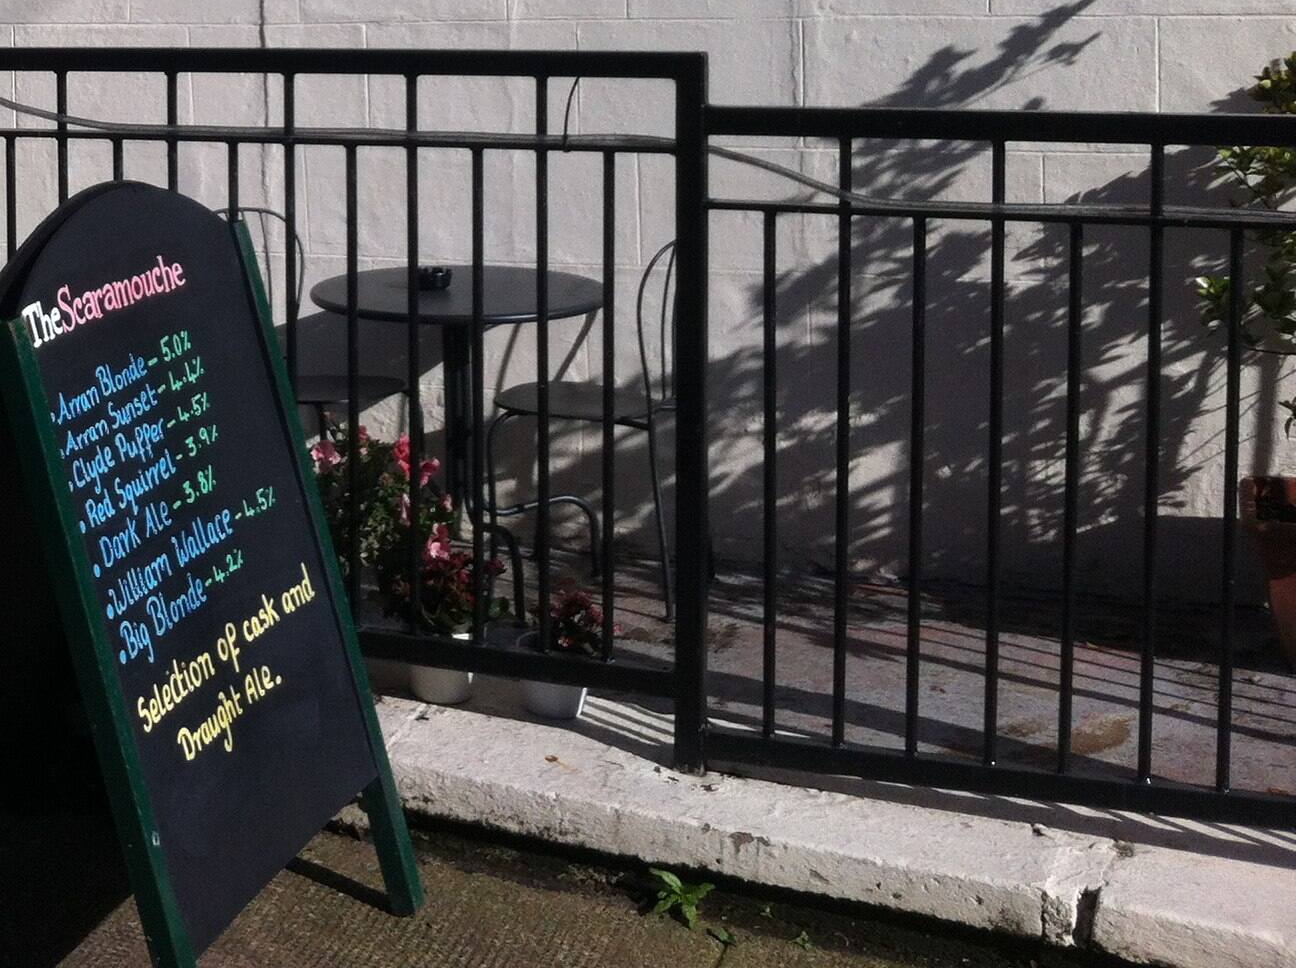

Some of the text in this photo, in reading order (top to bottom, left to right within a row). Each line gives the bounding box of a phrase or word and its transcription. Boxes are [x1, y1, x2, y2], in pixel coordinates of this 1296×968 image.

[57, 392, 100, 425] Arran
[95, 352, 148, 396] Blonde
[160, 330, 192, 362] 5.0%
[65, 419, 110, 456] Arran
[108, 383, 158, 430] Sunset
[72, 445, 116, 494] Clyde
[85, 489, 115, 528] Red
[114, 448, 176, 516] Squirrel
[99, 516, 142, 568] Dark
[145, 500, 173, 538] Ale
[182, 464, 217, 504] 3.8%
[108, 553, 172, 616] William
[171, 508, 234, 568] Wallace
[119, 620, 154, 664] Big
[146, 572, 208, 637] Blonde
[137, 562, 316, 733] Selection of cask and
[177, 665, 283, 761] Draught Ale.
